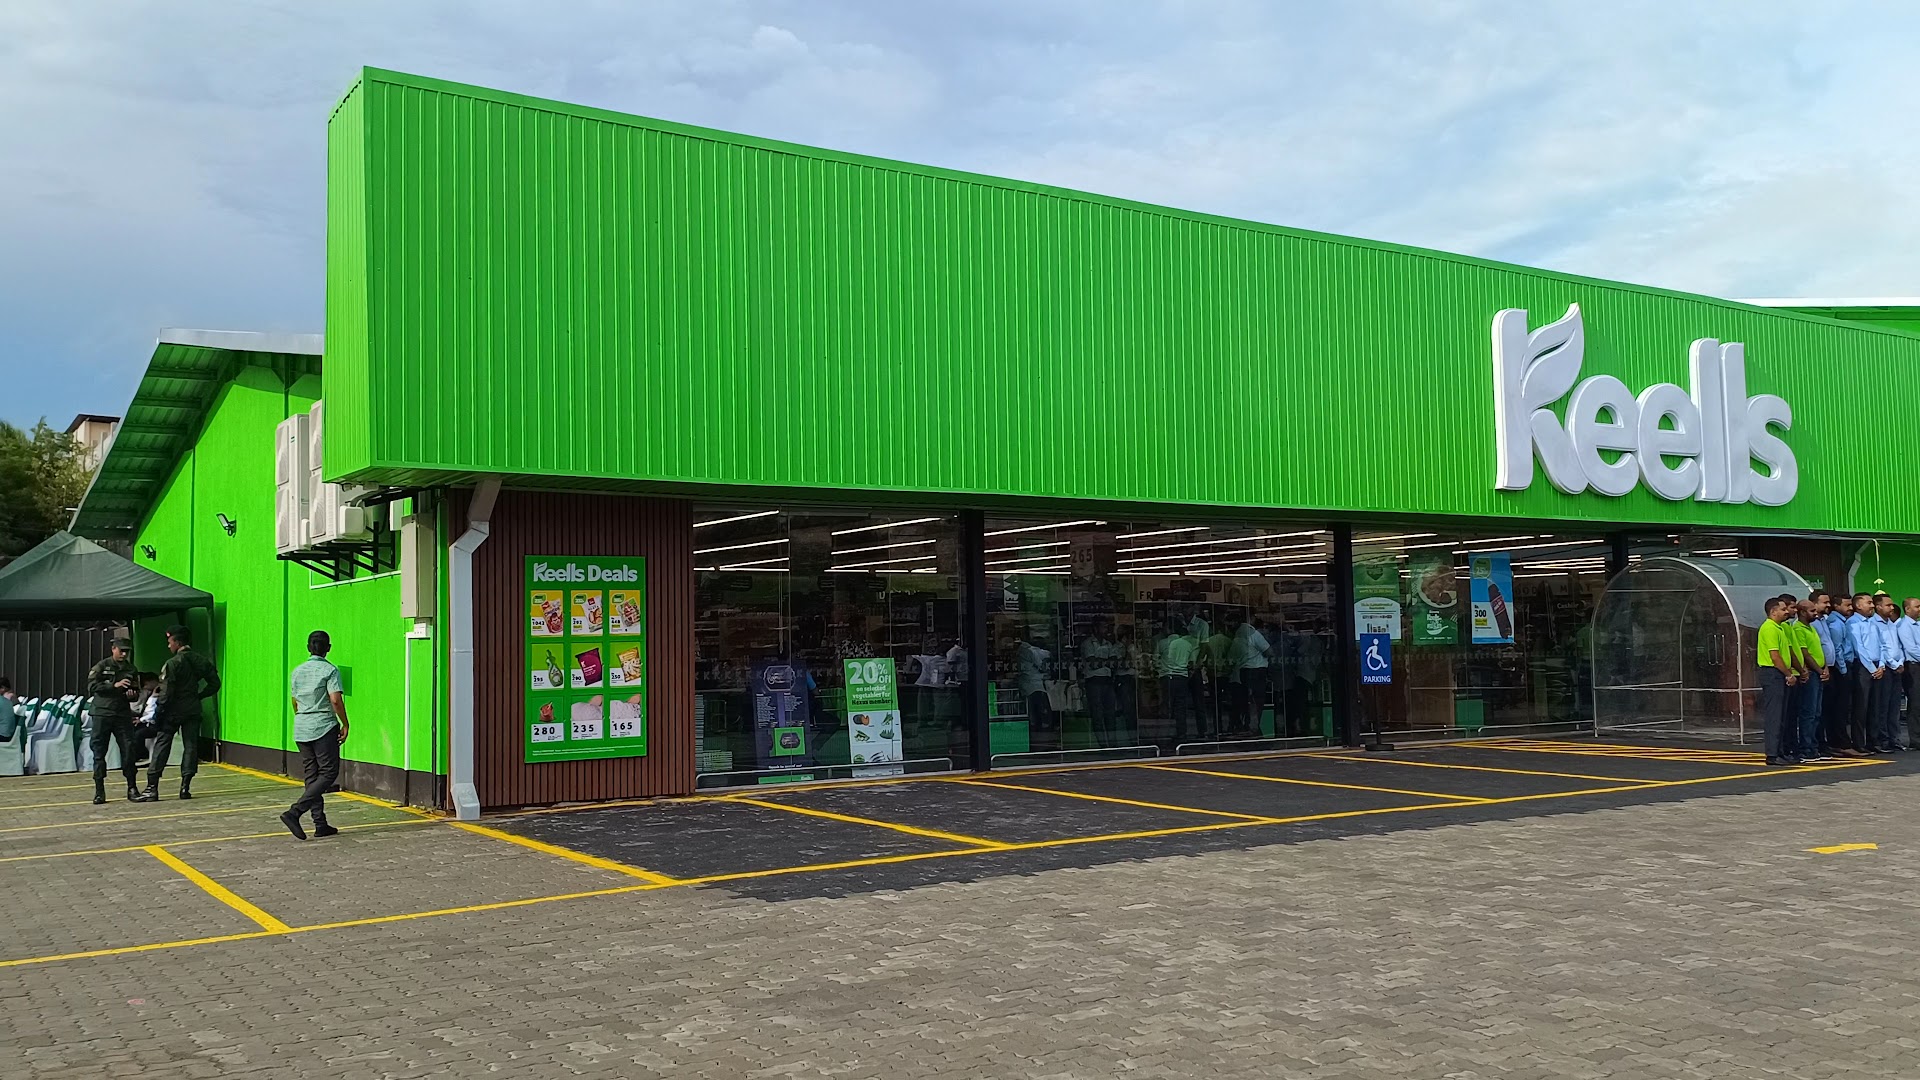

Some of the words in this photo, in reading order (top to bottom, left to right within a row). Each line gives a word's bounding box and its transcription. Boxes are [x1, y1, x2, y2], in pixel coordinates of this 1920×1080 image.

[1491, 301, 1798, 507] Keells
[1071, 548, 1092, 563] 265
[533, 561, 585, 583] Keells
[587, 563, 638, 582] Deals
[1474, 609, 1487, 618] 300
[848, 661, 888, 685] 20%
[1363, 675, 1391, 684] PARKING
[852, 692, 881, 700] vegetables
[533, 726, 555, 736] 280
[573, 724, 594, 733] 235
[613, 722, 633, 731] 165
